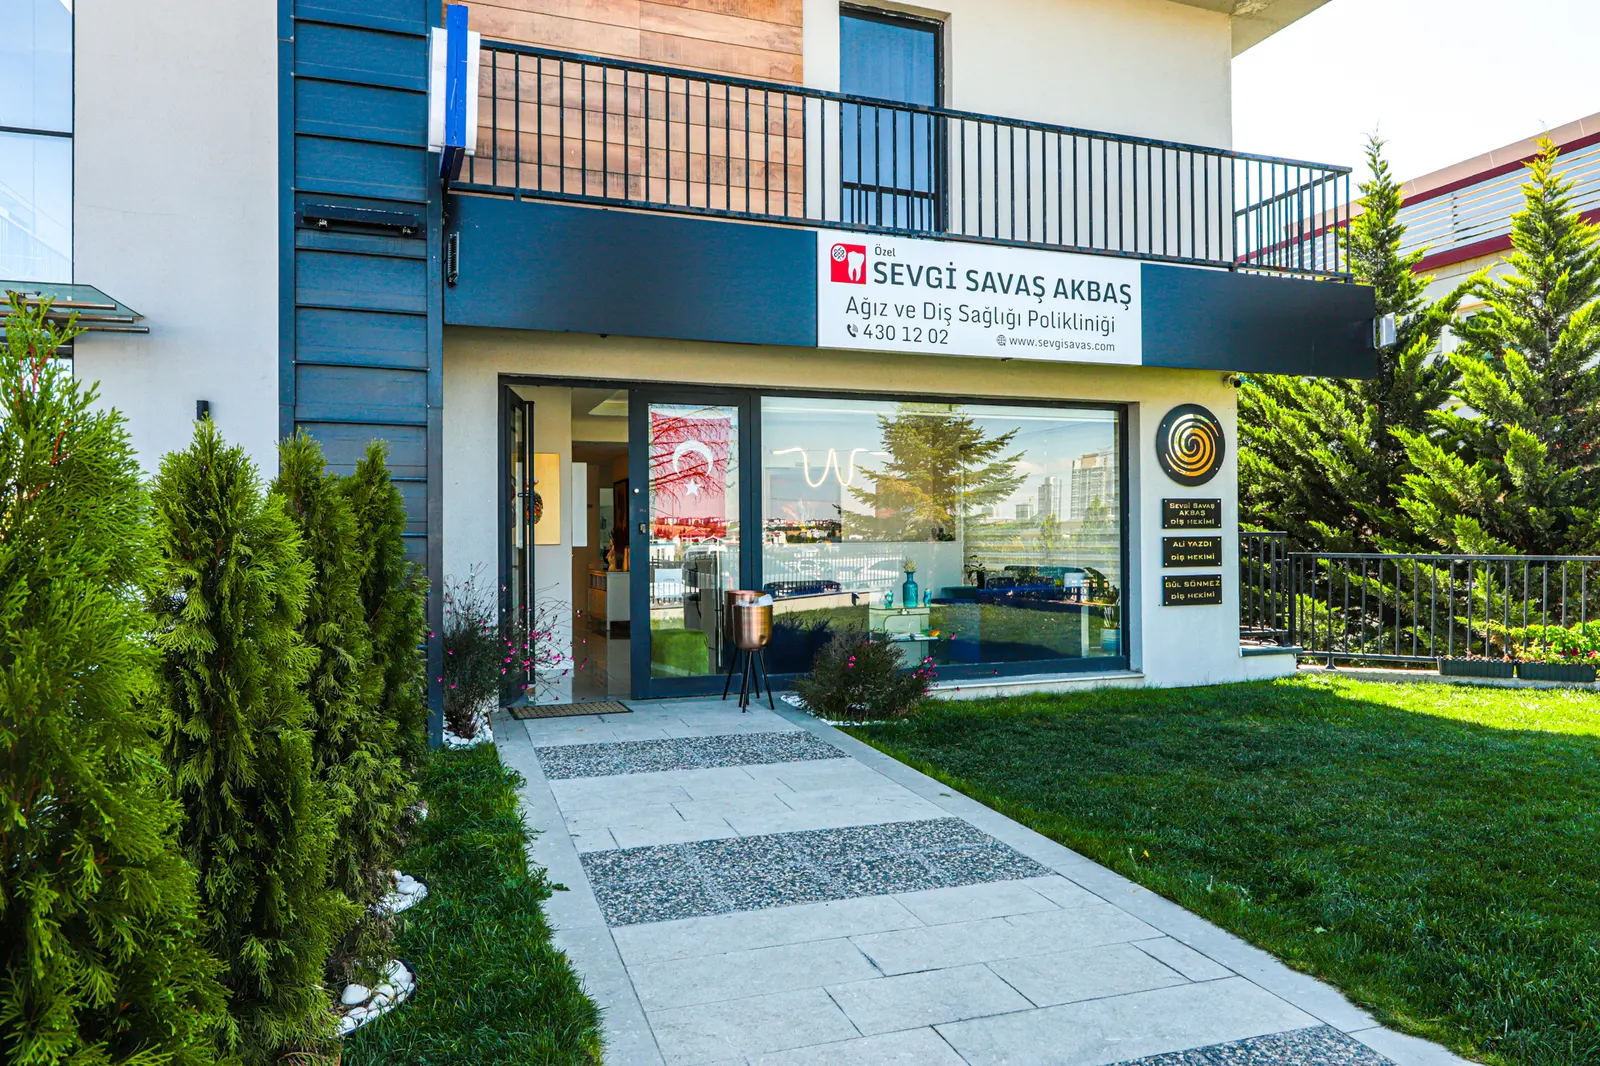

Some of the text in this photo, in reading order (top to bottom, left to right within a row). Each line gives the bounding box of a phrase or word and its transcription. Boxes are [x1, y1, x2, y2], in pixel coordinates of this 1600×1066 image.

[874, 244, 896, 257] Özel
[873, 262, 1132, 311] SEVGİ SAVAŞ AKBAŞ
[845, 296, 1115, 337] Ağız ve Diş Sağlığı Polikliniği
[863, 324, 949, 344] 430 12 02
[1009, 336, 1115, 352] www.sevgisavas.com
[1170, 518, 1185, 526] DİŞ
[1171, 553, 1185, 562] DİŞ
[1183, 580, 1220, 588] SÖNMEZ
[1171, 591, 1215, 601] DİŞ HEKİMİ
